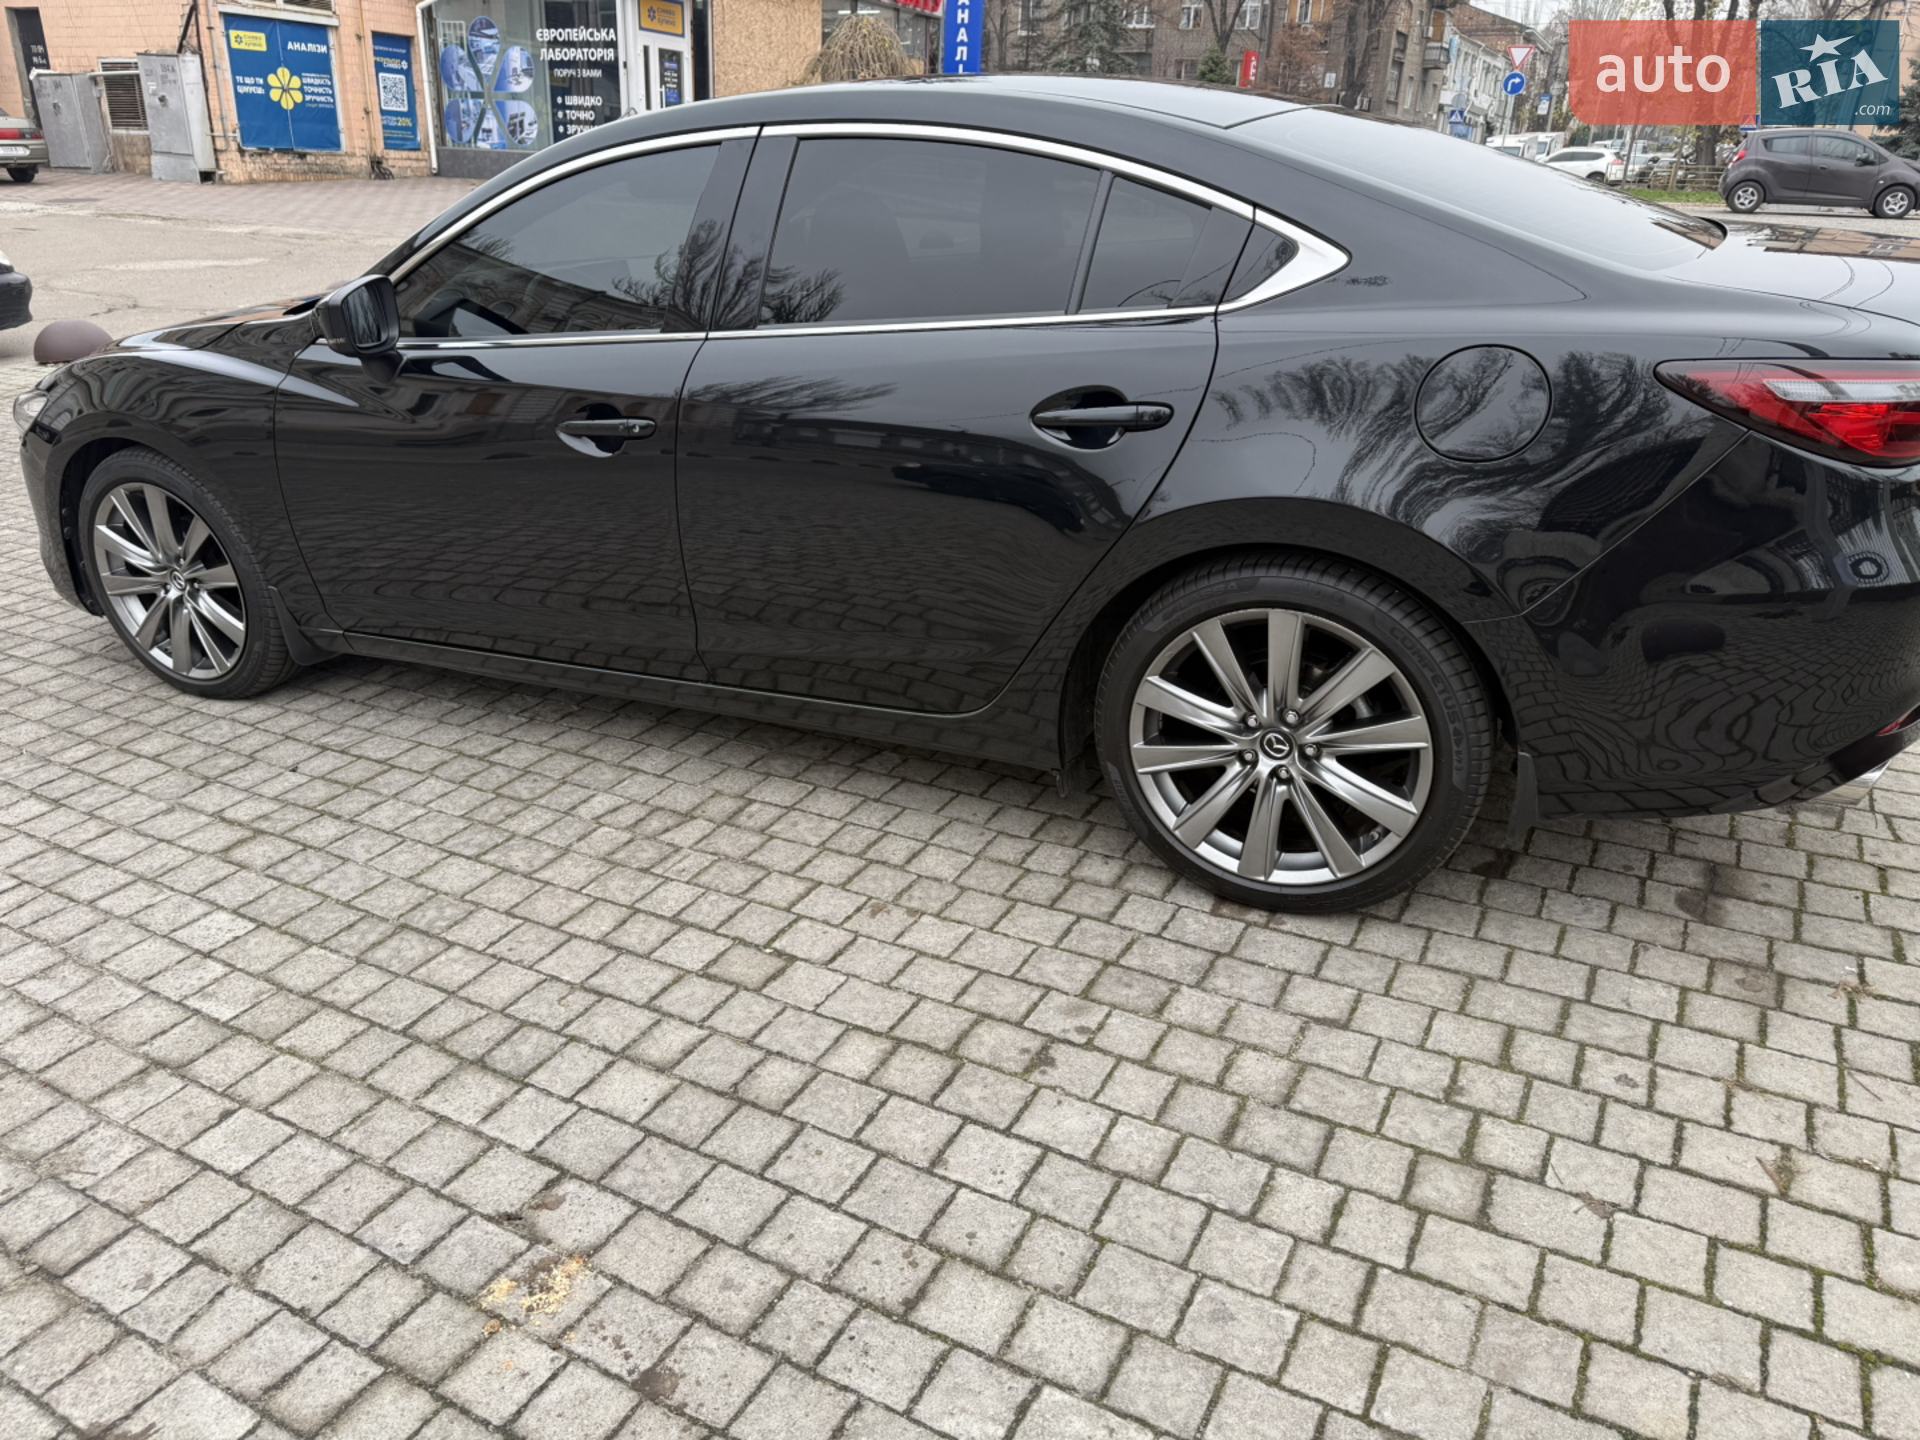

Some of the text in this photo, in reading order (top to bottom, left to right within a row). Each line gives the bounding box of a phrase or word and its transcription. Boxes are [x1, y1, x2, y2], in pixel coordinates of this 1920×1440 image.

[536, 26, 616, 41] ЄВРОПЕЙСЬКА
[287, 41, 327, 54] АНАЛІЗИ
[540, 48, 614, 61] ЛАБОРАТОРІЯ
[554, 68, 576, 78] ПОРУЧ
[583, 69, 602, 78] ВАМИ
[565, 95, 603, 108] ШВИДКО
[565, 110, 595, 121] ТОЧНО
[566, 125, 601, 135] ЗРУЧН
[1390, 625, 1461, 725] COMPETUS
